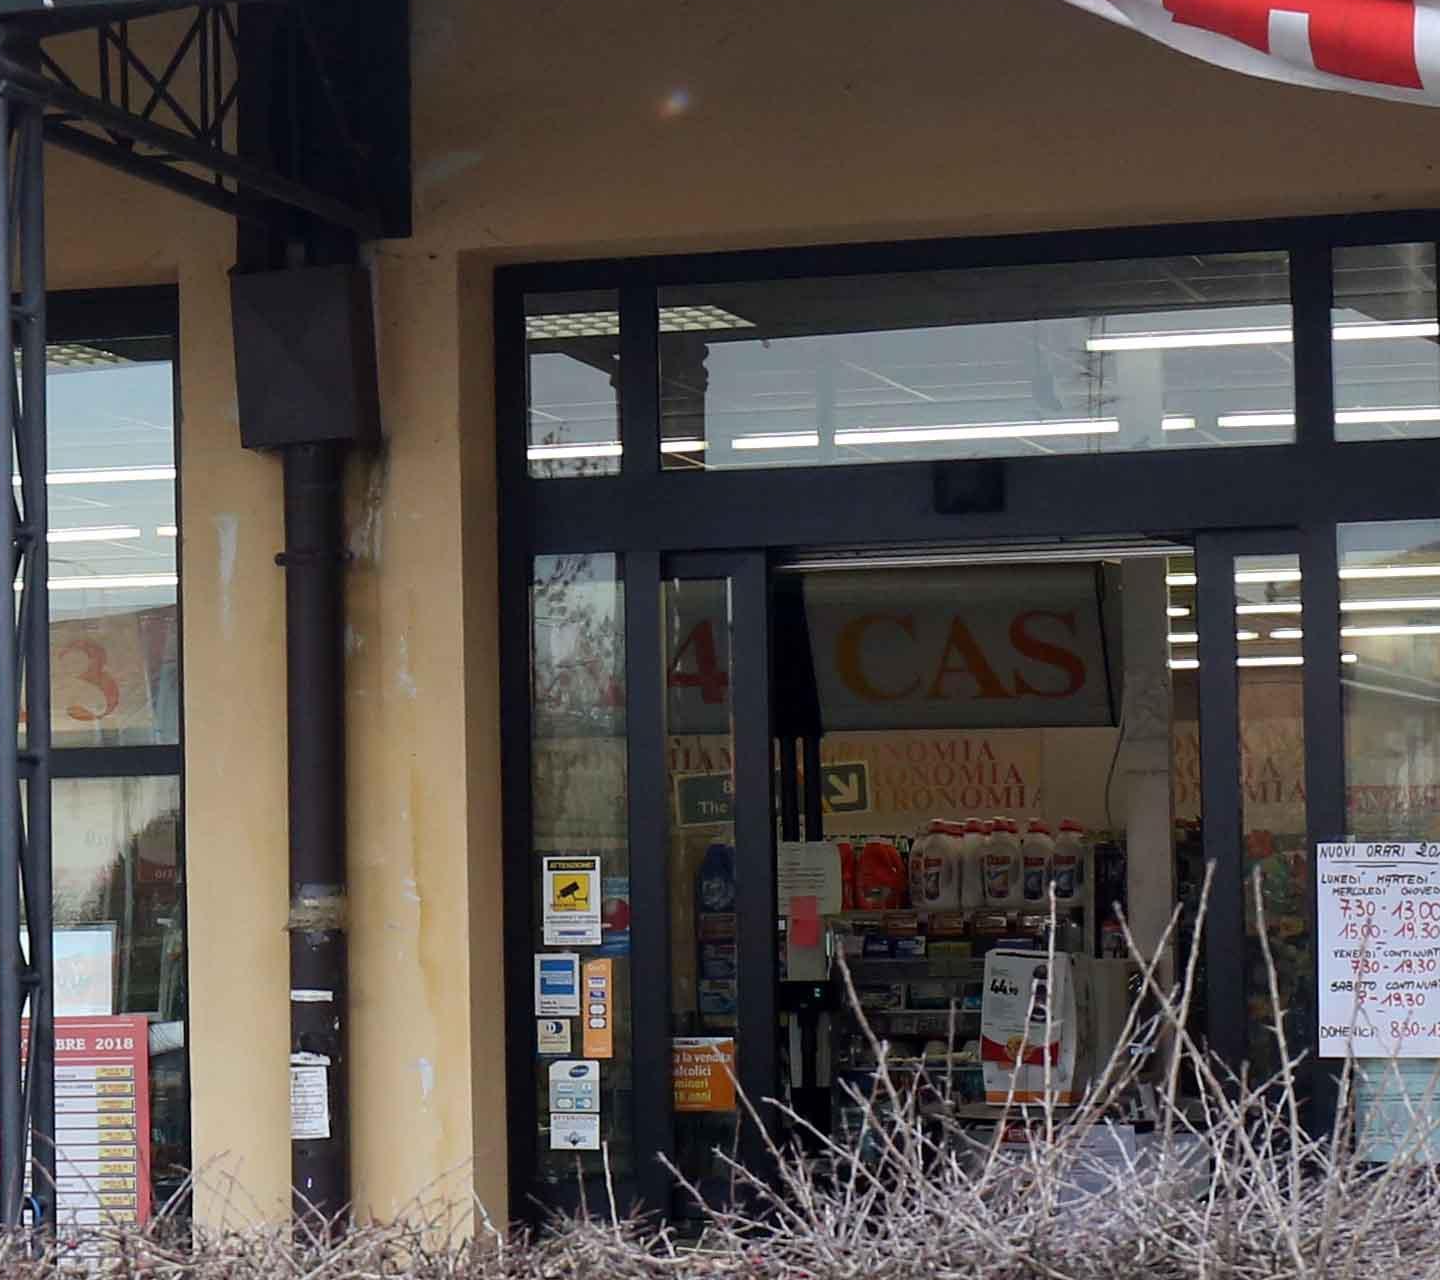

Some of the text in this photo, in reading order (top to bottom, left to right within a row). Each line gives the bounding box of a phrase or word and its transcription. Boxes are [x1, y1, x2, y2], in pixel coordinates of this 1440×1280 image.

[834, 610, 1087, 704] CAS
[1319, 845, 1356, 858] NUOVI
[1366, 845, 1406, 858] ORARI
[95, 1038, 134, 1050] 2018
